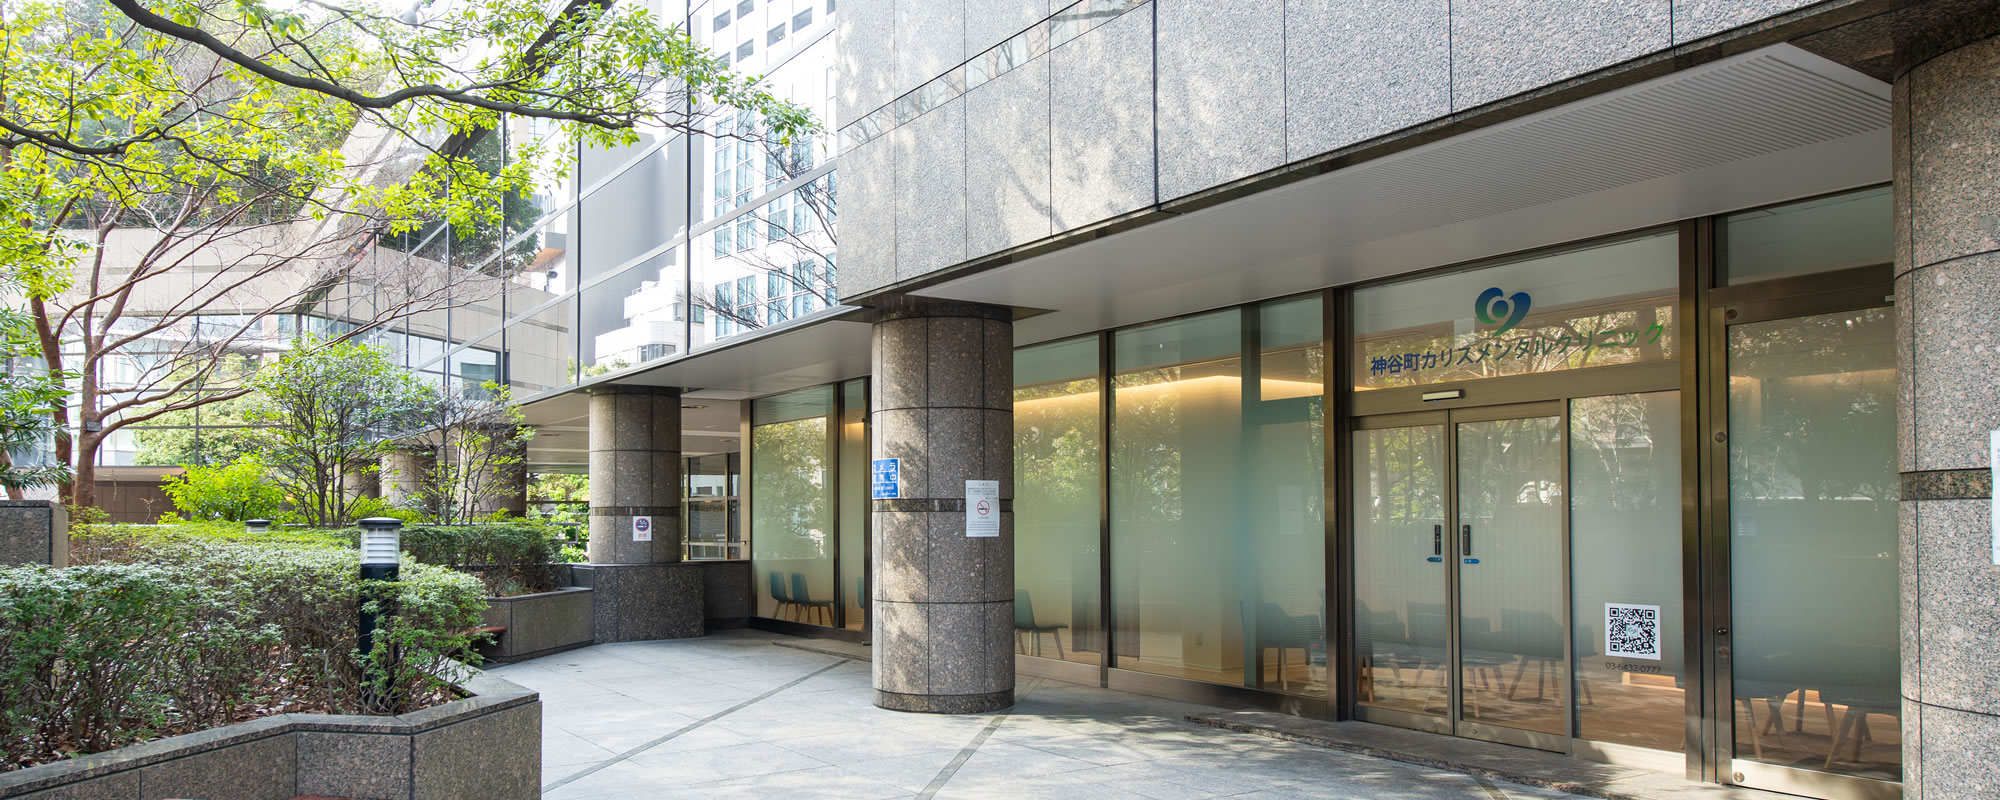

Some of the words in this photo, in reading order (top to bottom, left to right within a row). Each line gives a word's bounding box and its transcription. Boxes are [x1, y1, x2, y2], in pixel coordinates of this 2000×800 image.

[1370, 322, 1664, 376] 神谷町カリスメンタルクリニック
[1605, 662, 1661, 673] 03-6432-0777
